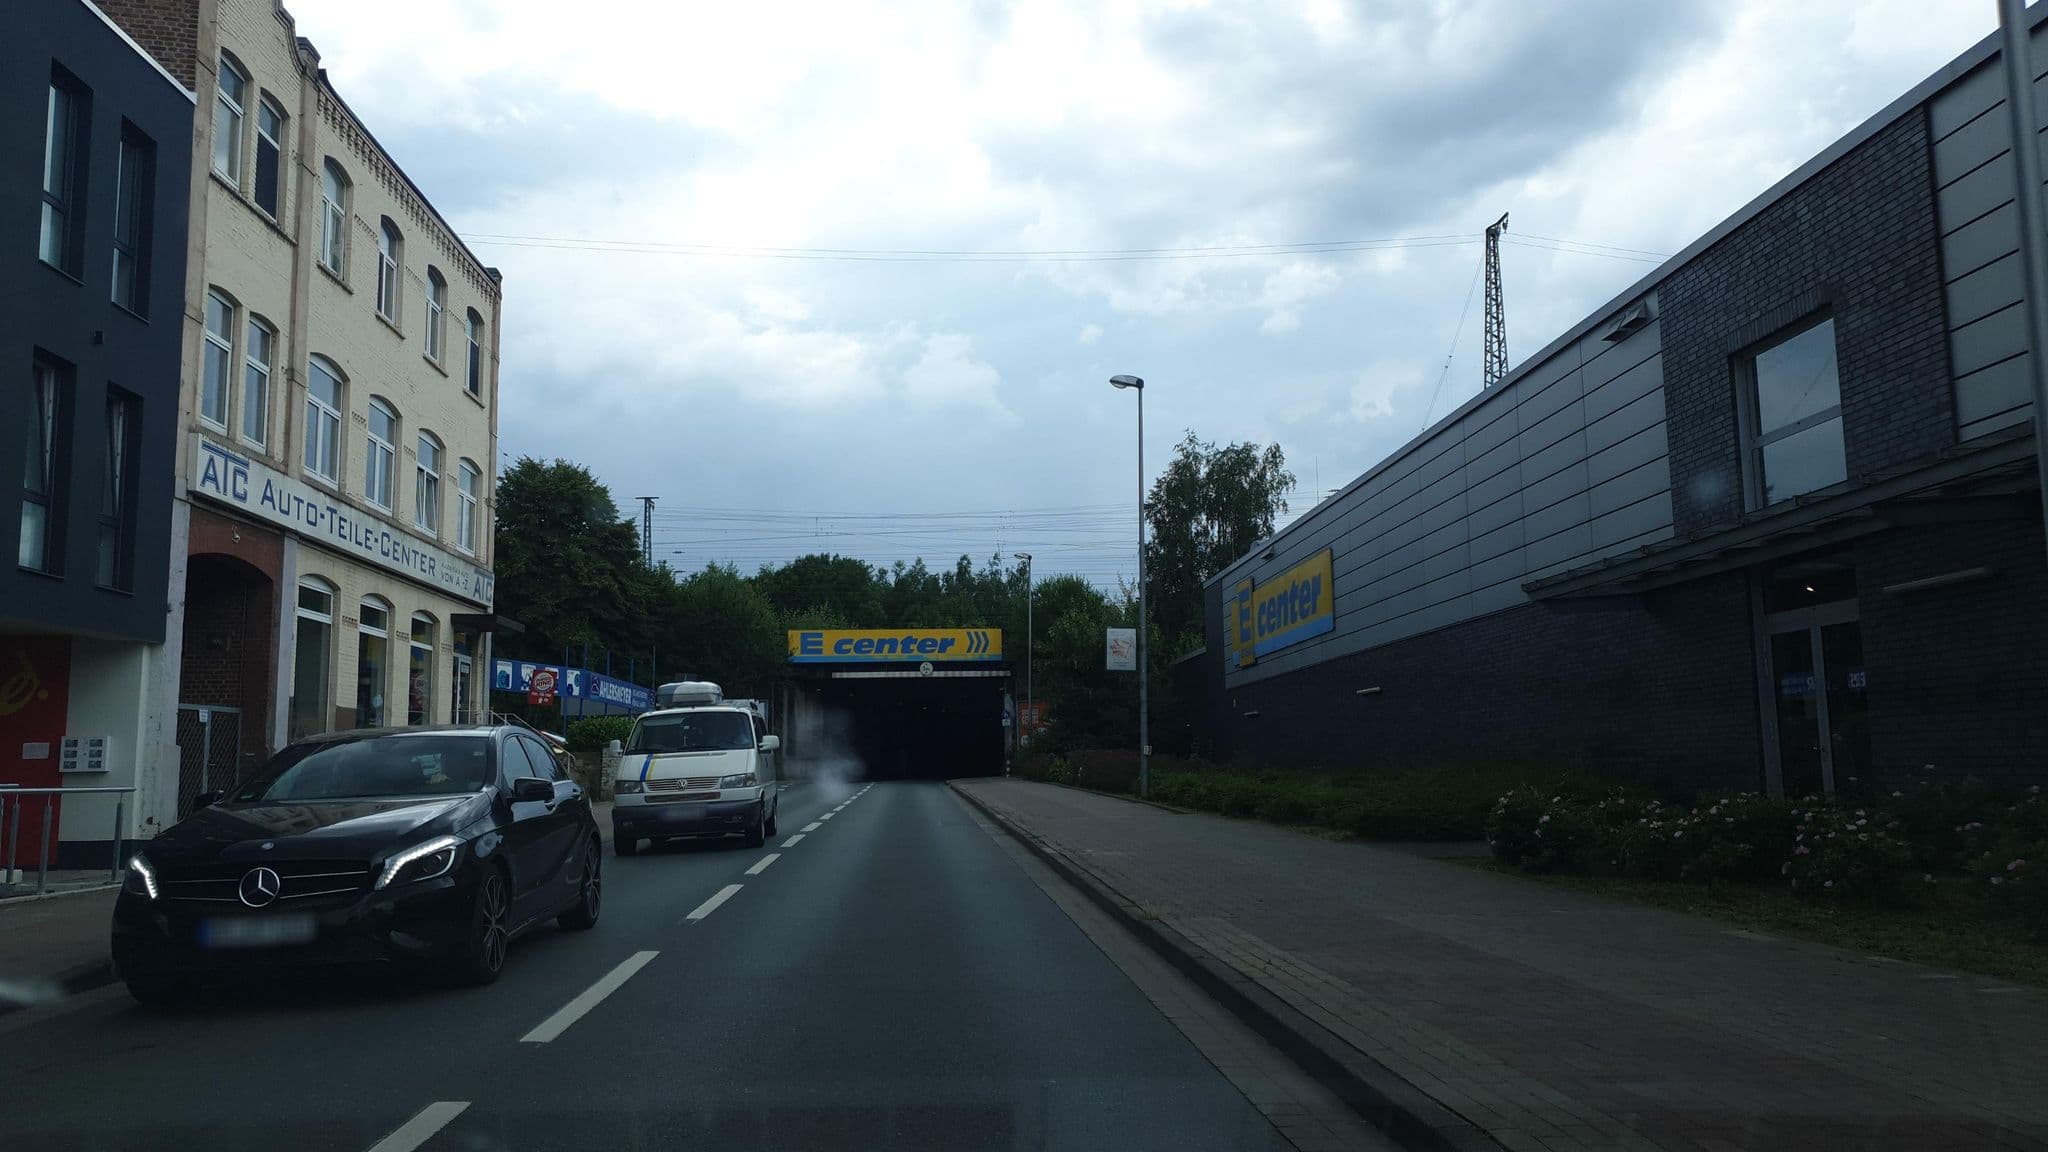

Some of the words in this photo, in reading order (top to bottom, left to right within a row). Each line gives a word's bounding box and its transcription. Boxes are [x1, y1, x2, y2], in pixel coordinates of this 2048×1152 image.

[200, 440, 249, 502] ATC
[473, 567, 494, 602] ATC
[1239, 586, 1251, 643] E
[1257, 572, 1322, 638] center
[800, 632, 824, 655] E
[833, 635, 956, 655] center
